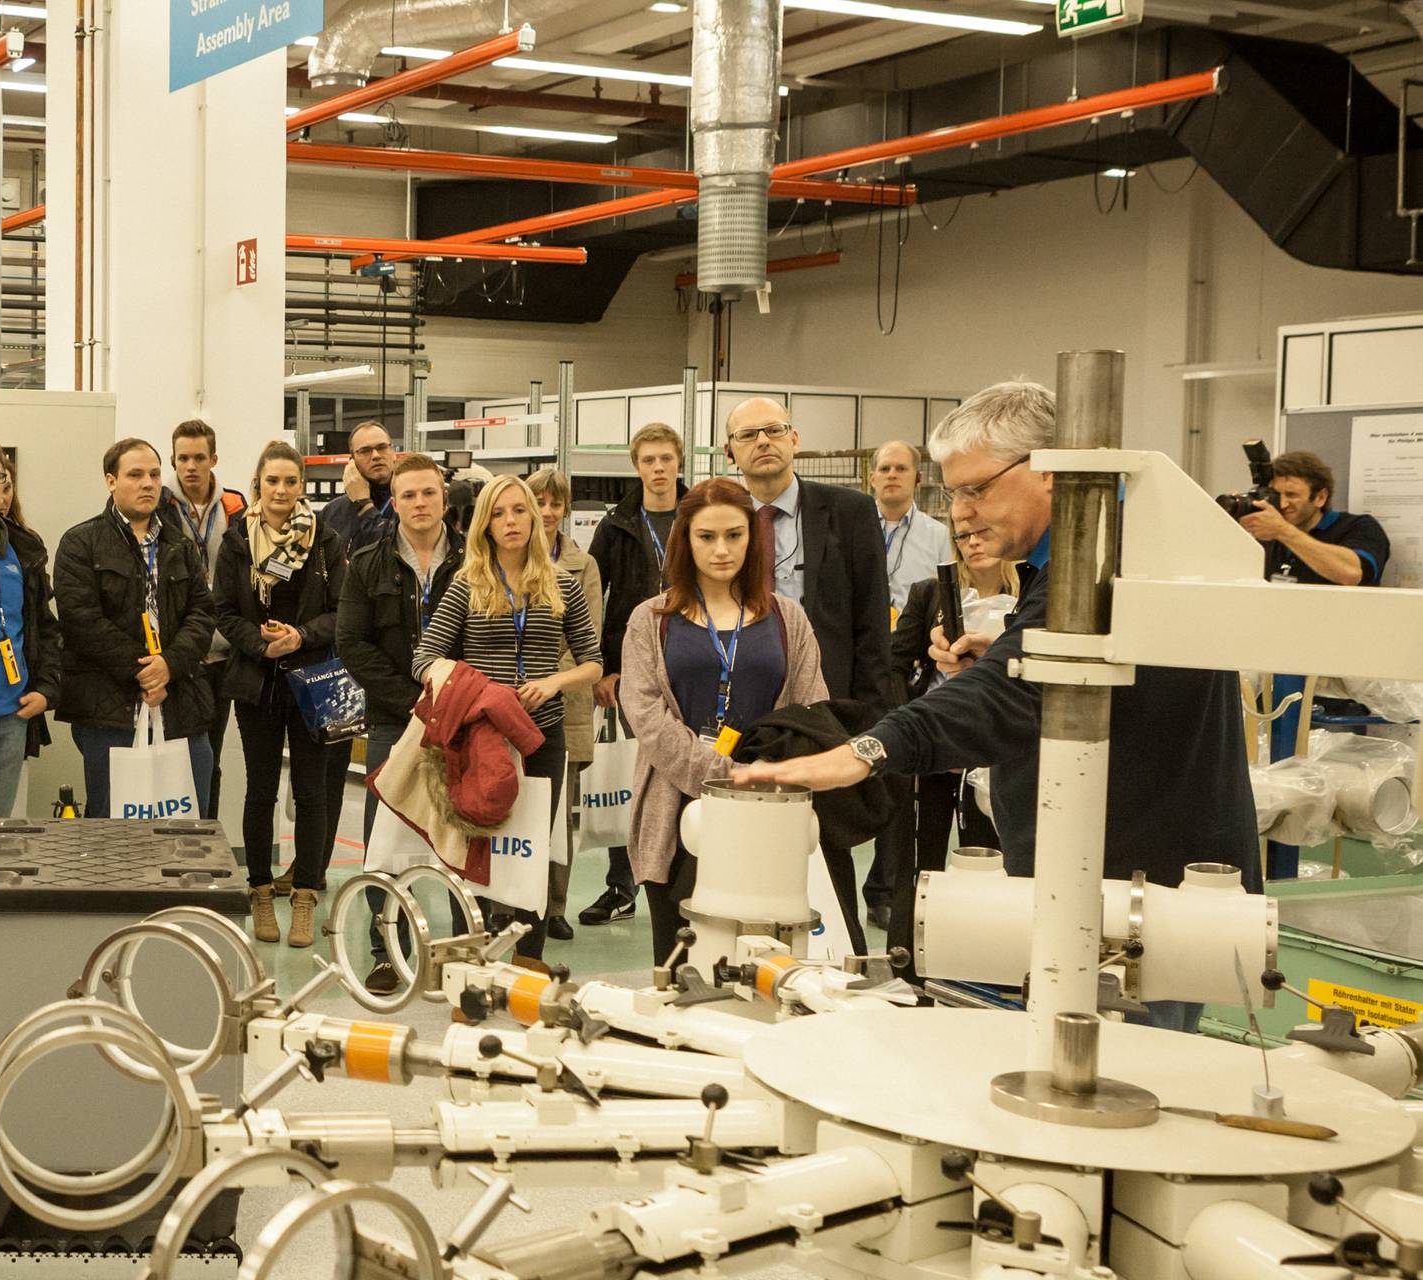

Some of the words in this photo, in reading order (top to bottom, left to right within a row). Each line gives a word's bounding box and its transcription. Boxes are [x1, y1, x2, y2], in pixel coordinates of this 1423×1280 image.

[195, 12, 255, 58] Assembly
[257, 1, 291, 31] Area
[583, 789, 632, 809] PHILIP
[491, 836, 532, 858] LIPS
[1380, 1000, 1392, 1010] mit
[1394, 1003, 1416, 1015] Stator
